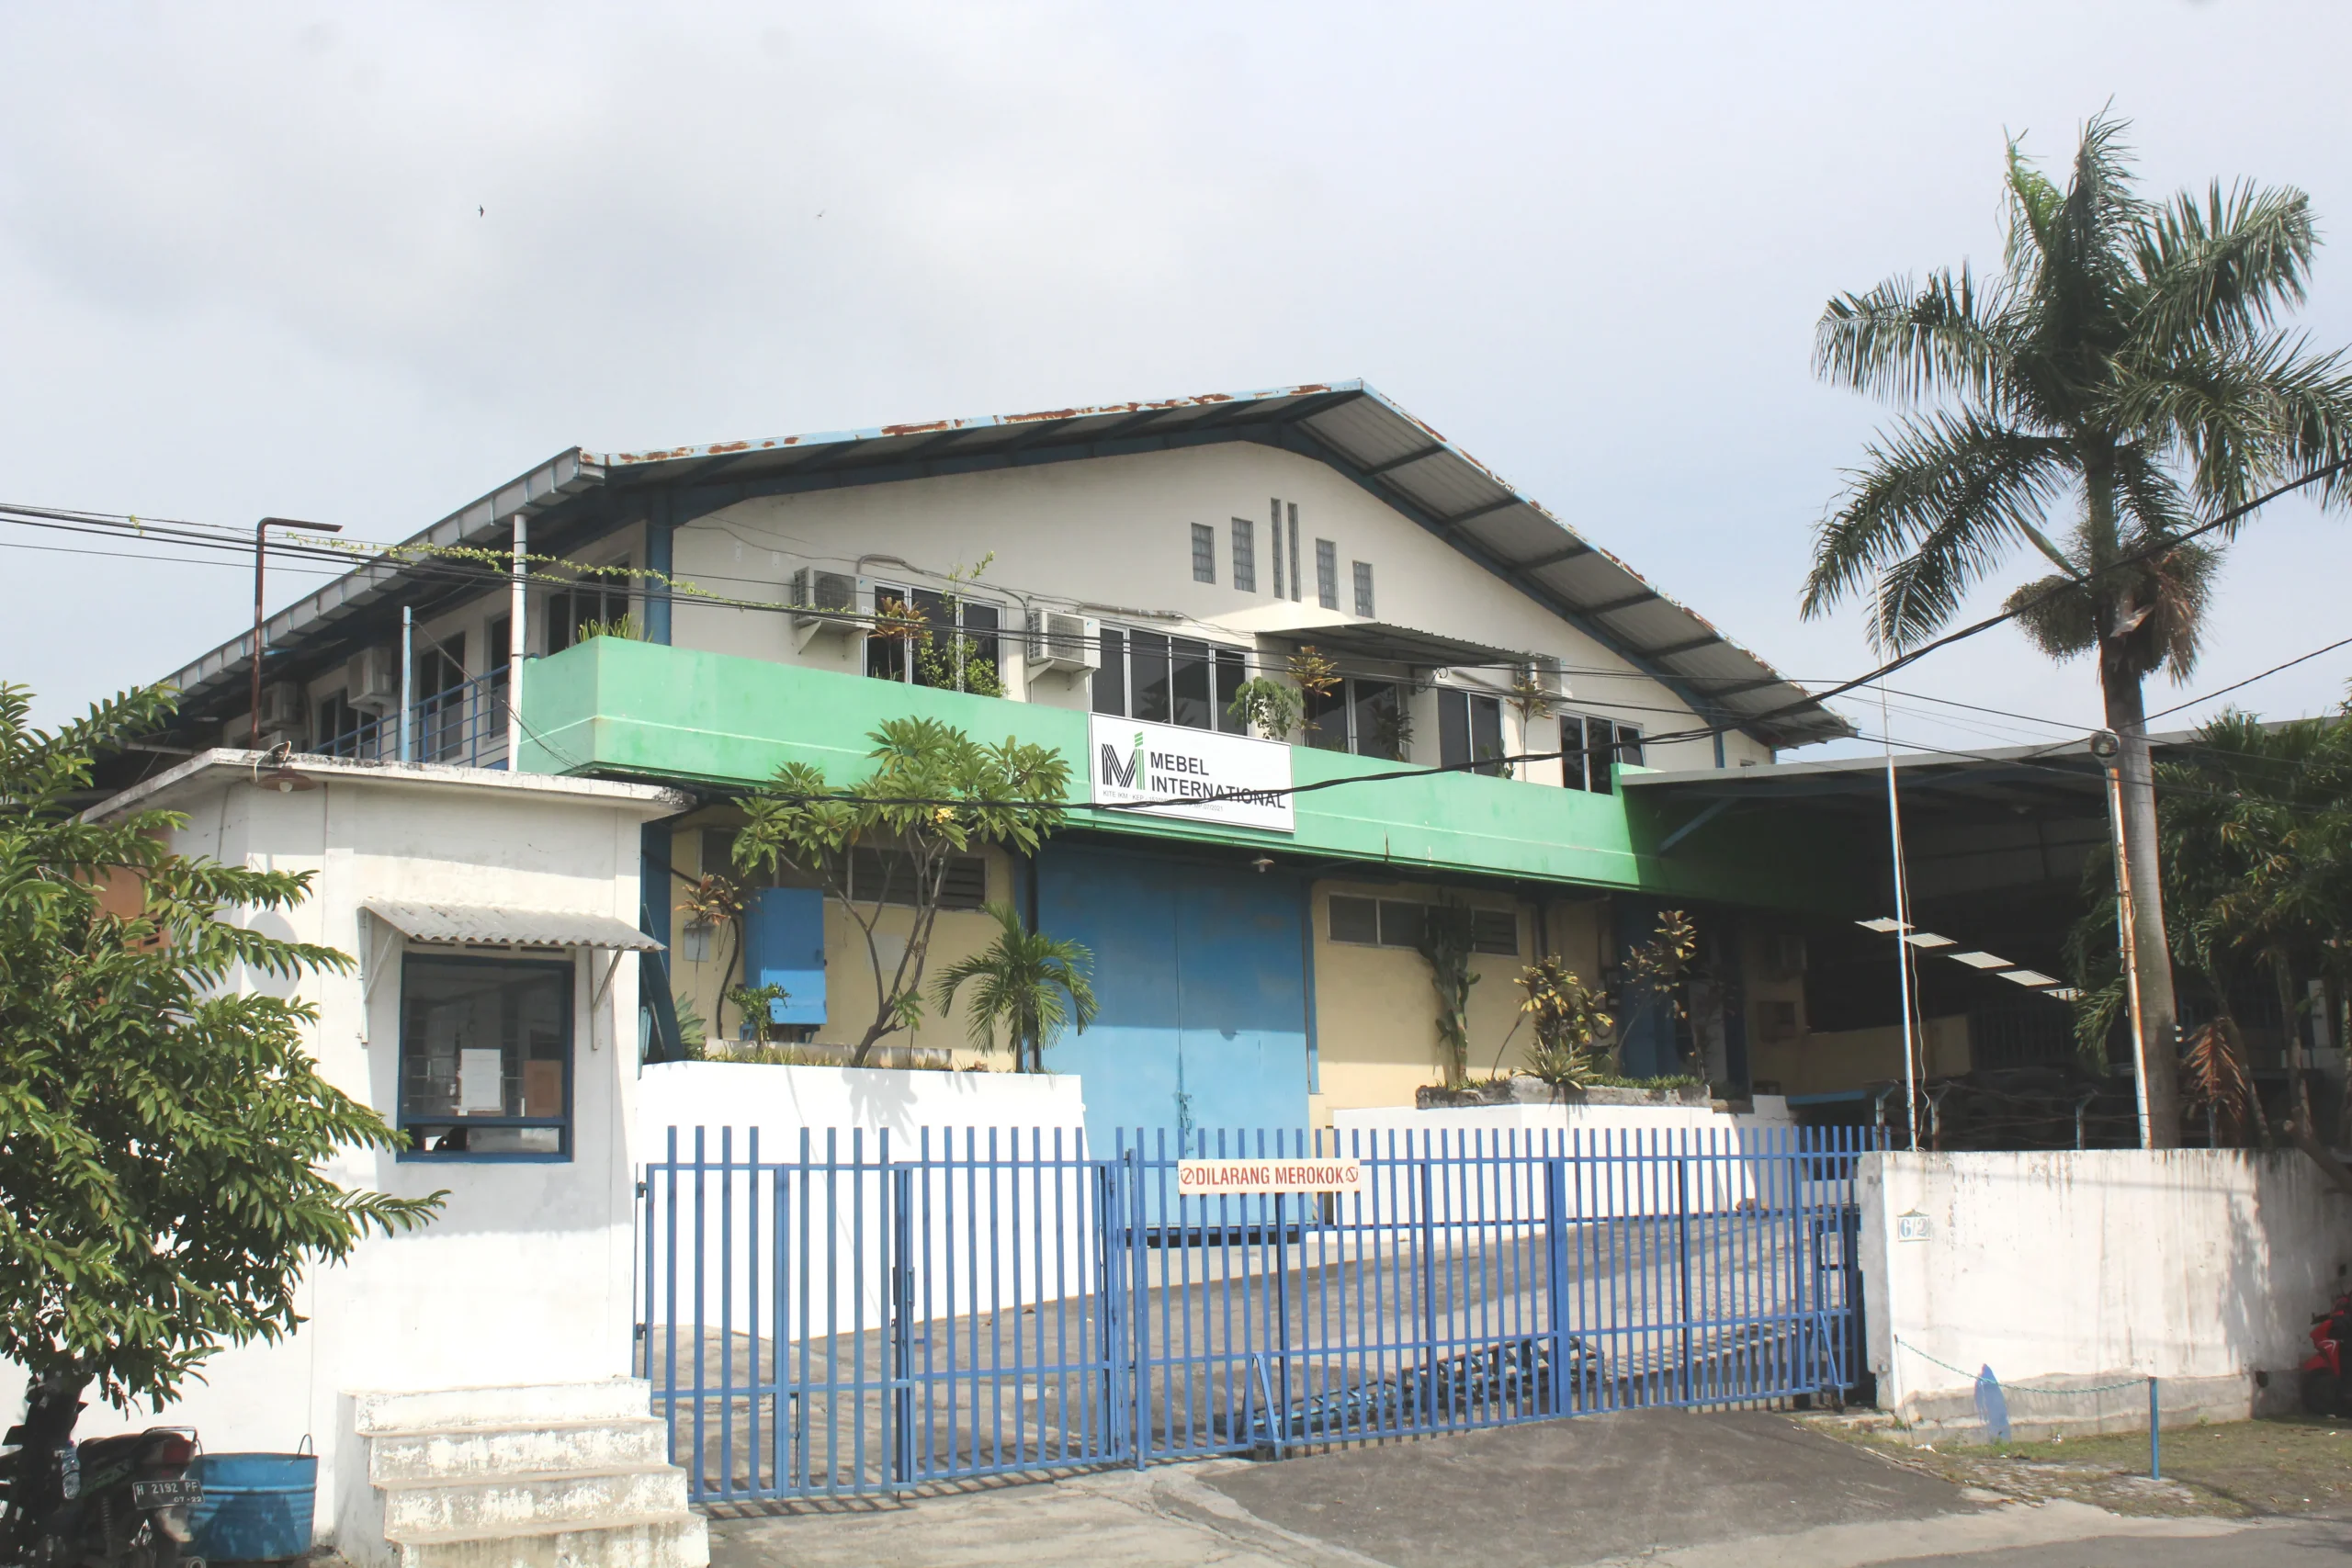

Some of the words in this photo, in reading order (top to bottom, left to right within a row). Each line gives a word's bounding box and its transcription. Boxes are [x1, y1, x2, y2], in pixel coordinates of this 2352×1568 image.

[1150, 751, 1209, 776] MEBEL
[1102, 790, 1116, 798] KITE
[1151, 774, 1286, 809] INTERNATIONAL
[1196, 1167, 1270, 1186] DILARANG
[1275, 1166, 1344, 1185] MEROKOK
[136, 1484, 144, 1495] H
[152, 1483, 178, 1495] 2192
[185, 1482, 198, 1493] PF
